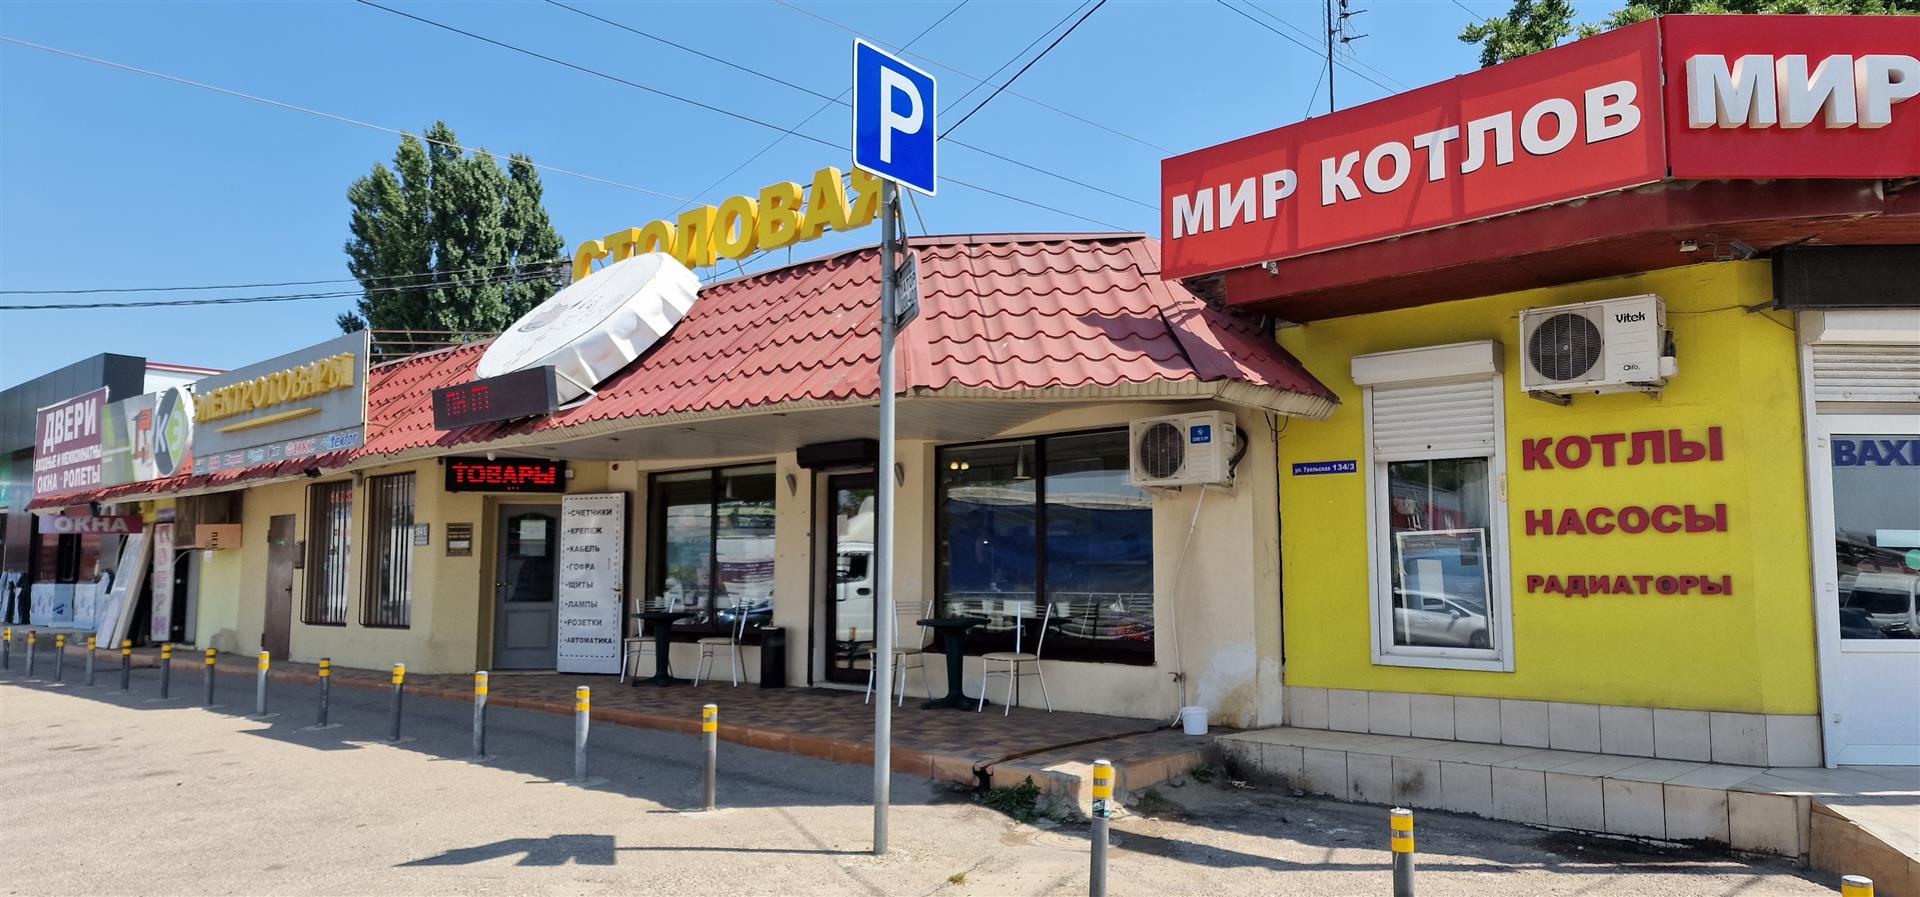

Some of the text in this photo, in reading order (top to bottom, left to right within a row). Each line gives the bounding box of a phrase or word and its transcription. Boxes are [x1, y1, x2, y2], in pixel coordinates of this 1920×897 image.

[1686, 54, 1920, 129] МИР
[880, 65, 924, 164] P
[1171, 80, 1641, 239] МИР КОТЛОВ
[1615, 311, 1645, 324] Vitek
[193, 352, 355, 423] ЭЛЕКТРОТОВАРЫ
[42, 397, 97, 455] ДВЕРИ
[1522, 426, 1724, 470] КОТЛЫ
[452, 464, 556, 484] ТОВАРЫ
[1303, 466, 1331, 474] Уральская
[1332, 463, 1355, 471] 134/3
[37, 464, 101, 494] ОКНА РОЛЕТЫ
[570, 508, 613, 517] СЧЕТЧИКИ
[1525, 503, 1728, 536] НАСОСЫ
[54, 516, 130, 533] ОКНА
[570, 527, 603, 535] КРЕПЕЖ
[569, 545, 601, 553] КАБЕЛЬ
[568, 563, 596, 571] ГОФРА
[568, 581, 594, 589] ЩИТЫ
[1526, 575, 1733, 598] РАДИАТОРЫ
[567, 600, 598, 609] ЛАМПЫ
[567, 618, 602, 627] РОЗЕТКИ
[566, 636, 613, 645] АВТОМАТИКА
